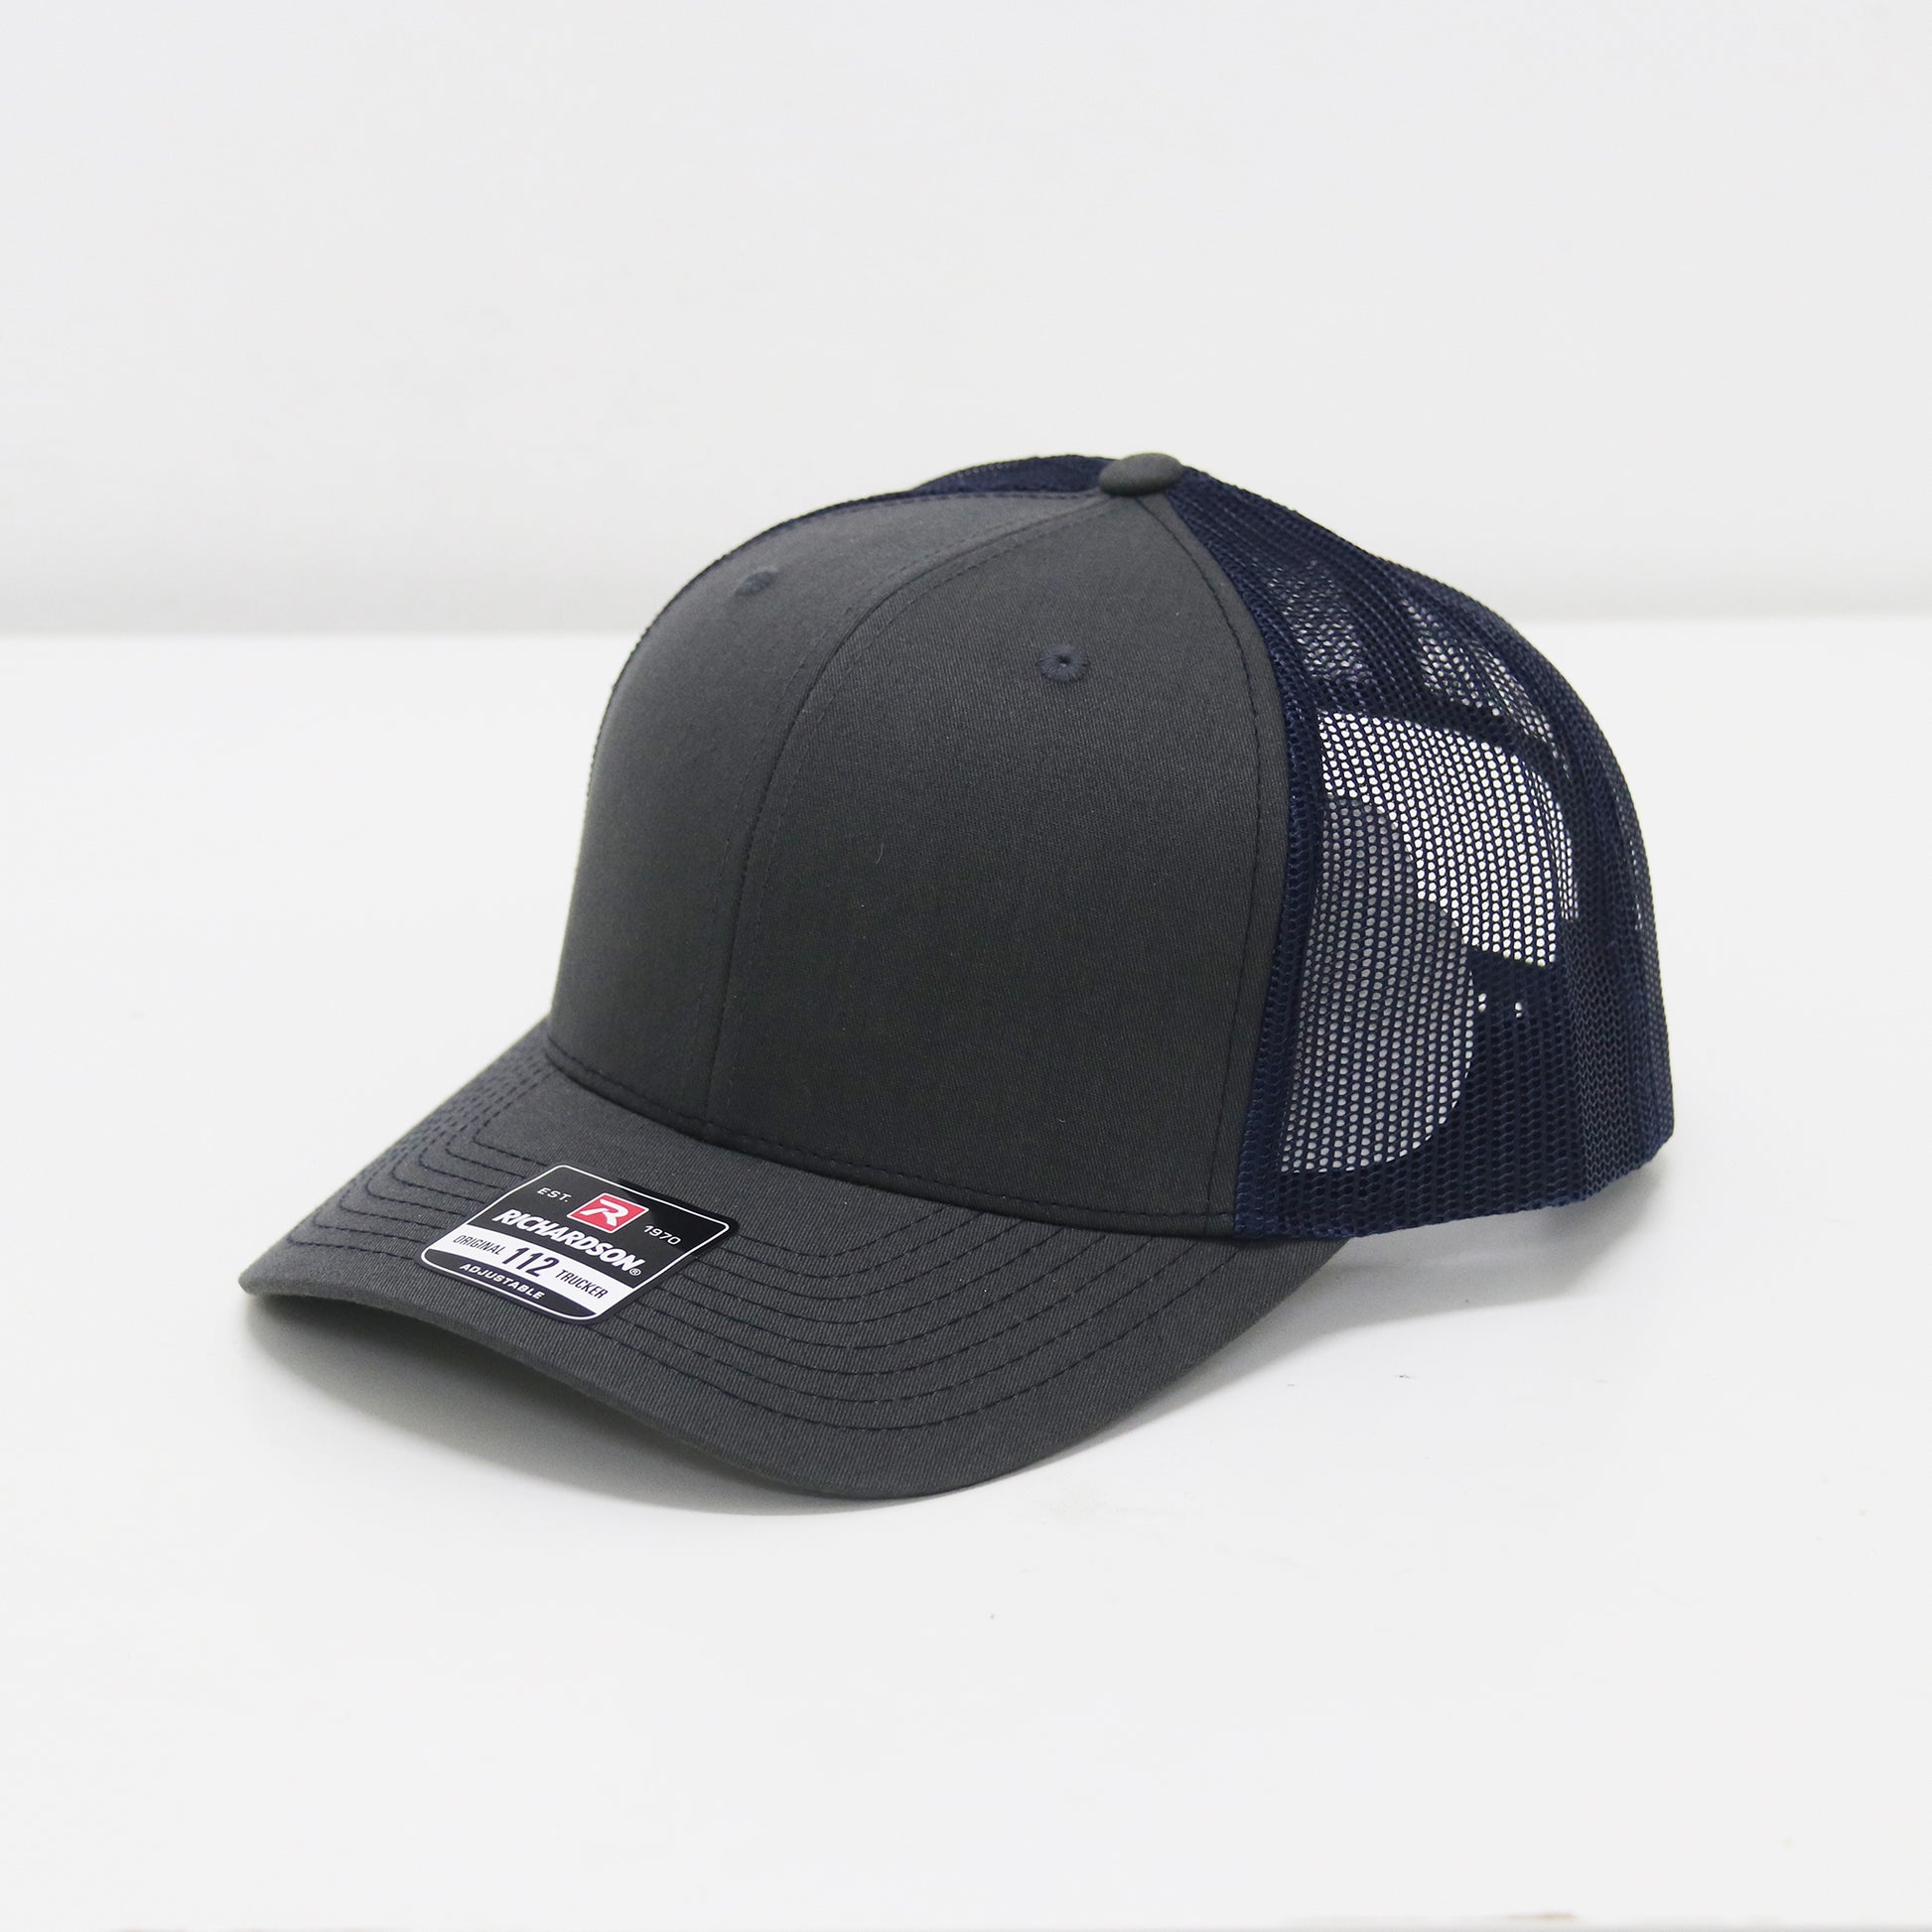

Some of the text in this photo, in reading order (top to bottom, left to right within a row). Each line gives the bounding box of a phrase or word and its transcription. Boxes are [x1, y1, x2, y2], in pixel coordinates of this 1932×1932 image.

[537, 1186, 572, 1202] EST.
[643, 1224, 682, 1246] 1970
[453, 1234, 609, 1301] ORIGINAL 112 TRUCKER
[459, 1263, 545, 1301] ADJUSTABLE
